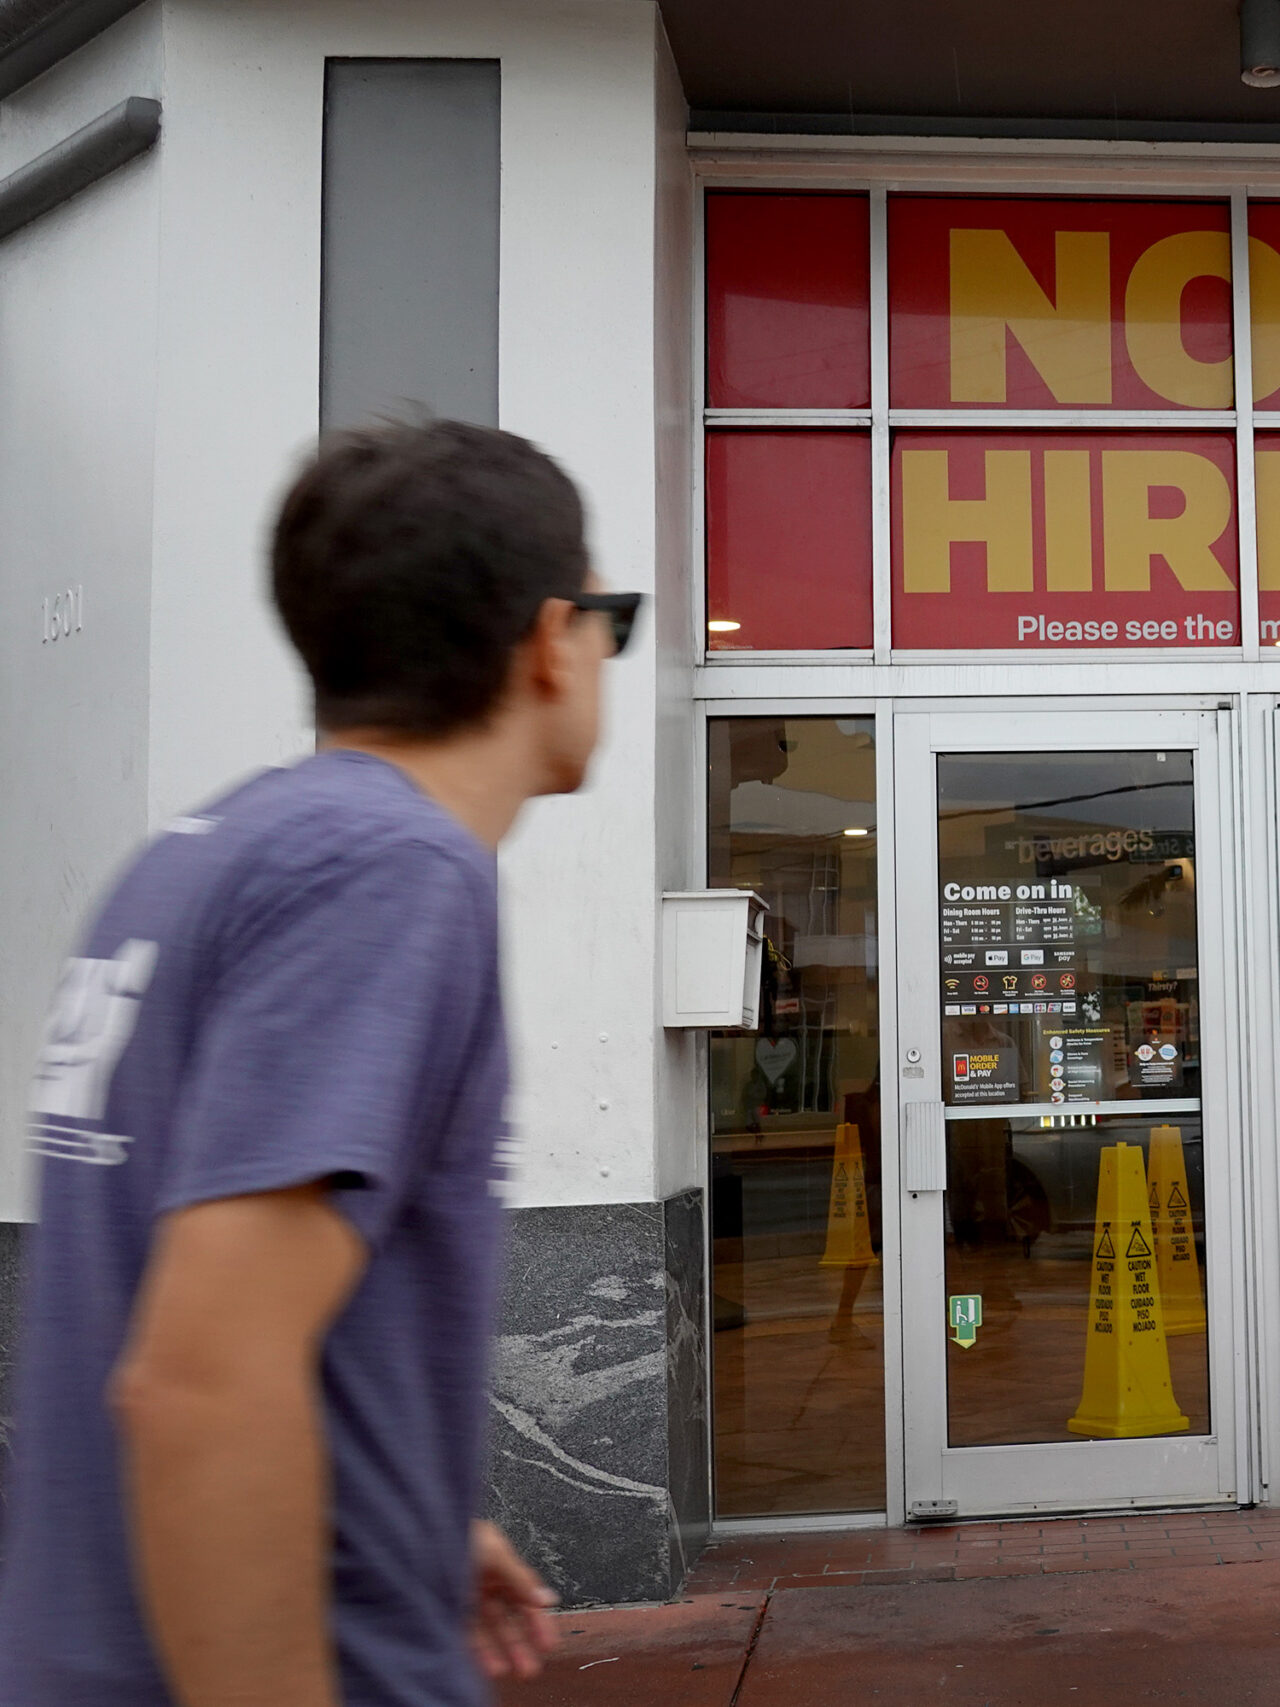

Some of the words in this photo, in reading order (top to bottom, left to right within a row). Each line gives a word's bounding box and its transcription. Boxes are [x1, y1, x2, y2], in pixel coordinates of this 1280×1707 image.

[41, 584, 82, 644] 1601
[1018, 614, 1119, 641] Please
[1125, 619, 1178, 640] see
[1184, 613, 1233, 640] the
[1018, 829, 1154, 864] beverages
[944, 882, 1012, 900] Come
[1016, 885, 1045, 900] on
[1050, 879, 1072, 899] in
[943, 908, 963, 918] Dining
[963, 908, 981, 916] Room
[981, 907, 1000, 916] Hours
[1015, 907, 1047, 915] Drive-Thru
[1047, 906, 1067, 915] Hours
[993, 954, 1006, 962] Pay
[1148, 981, 1178, 992] Thirsty?
[970, 1054, 999, 1062] MOBILE
[970, 1062, 997, 1070] ORDER
[977, 1069, 992, 1077] PAY
[1128, 1260, 1152, 1272] CAUTION
[1134, 1271, 1146, 1282] WET
[1132, 1283, 1150, 1294] FLOOR
[1131, 1297, 1155, 1309] CUIDADO
[1136, 1308, 1150, 1320] PISO
[1132, 1320, 1156, 1333] MOJADO
